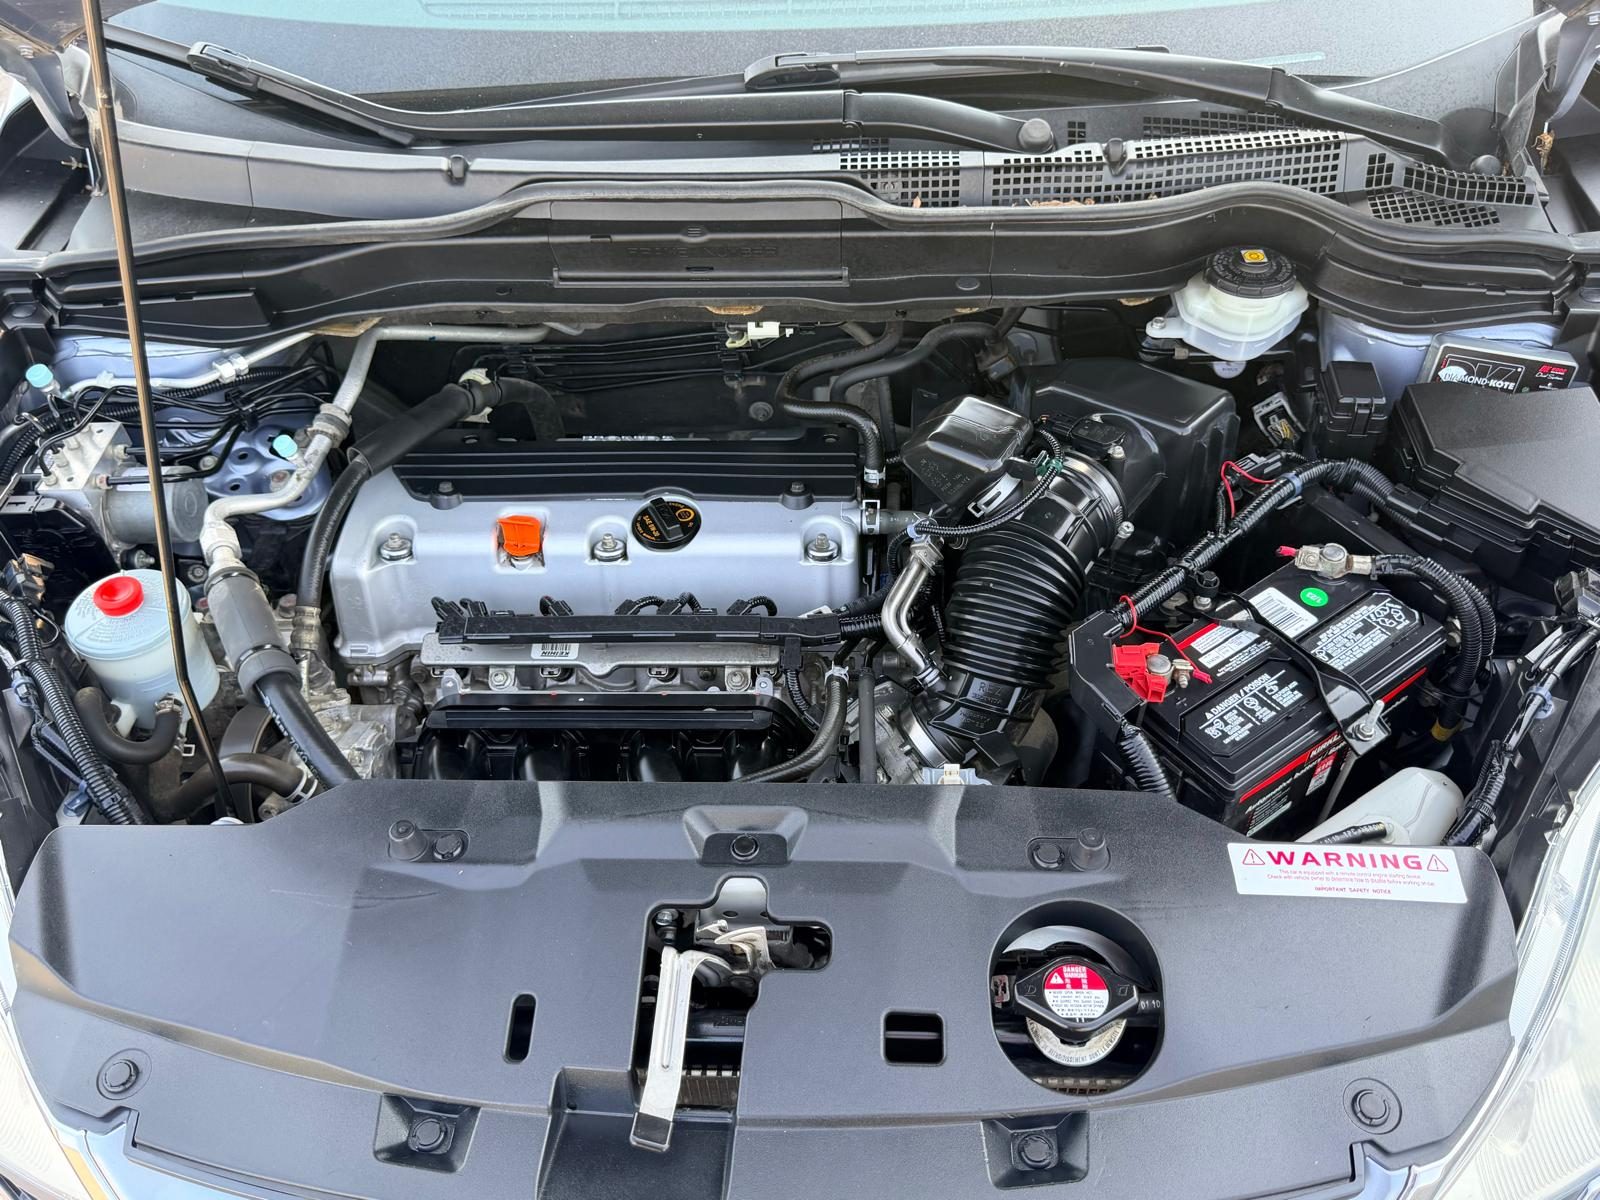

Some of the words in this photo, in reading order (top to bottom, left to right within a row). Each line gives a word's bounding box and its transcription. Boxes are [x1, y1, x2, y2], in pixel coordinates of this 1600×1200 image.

[1443, 371, 1516, 391] DIAMOND-KOTE
[1210, 693, 1241, 716] DANGER
[1242, 673, 1271, 694] POISON
[1266, 851, 1423, 870] WARNING
